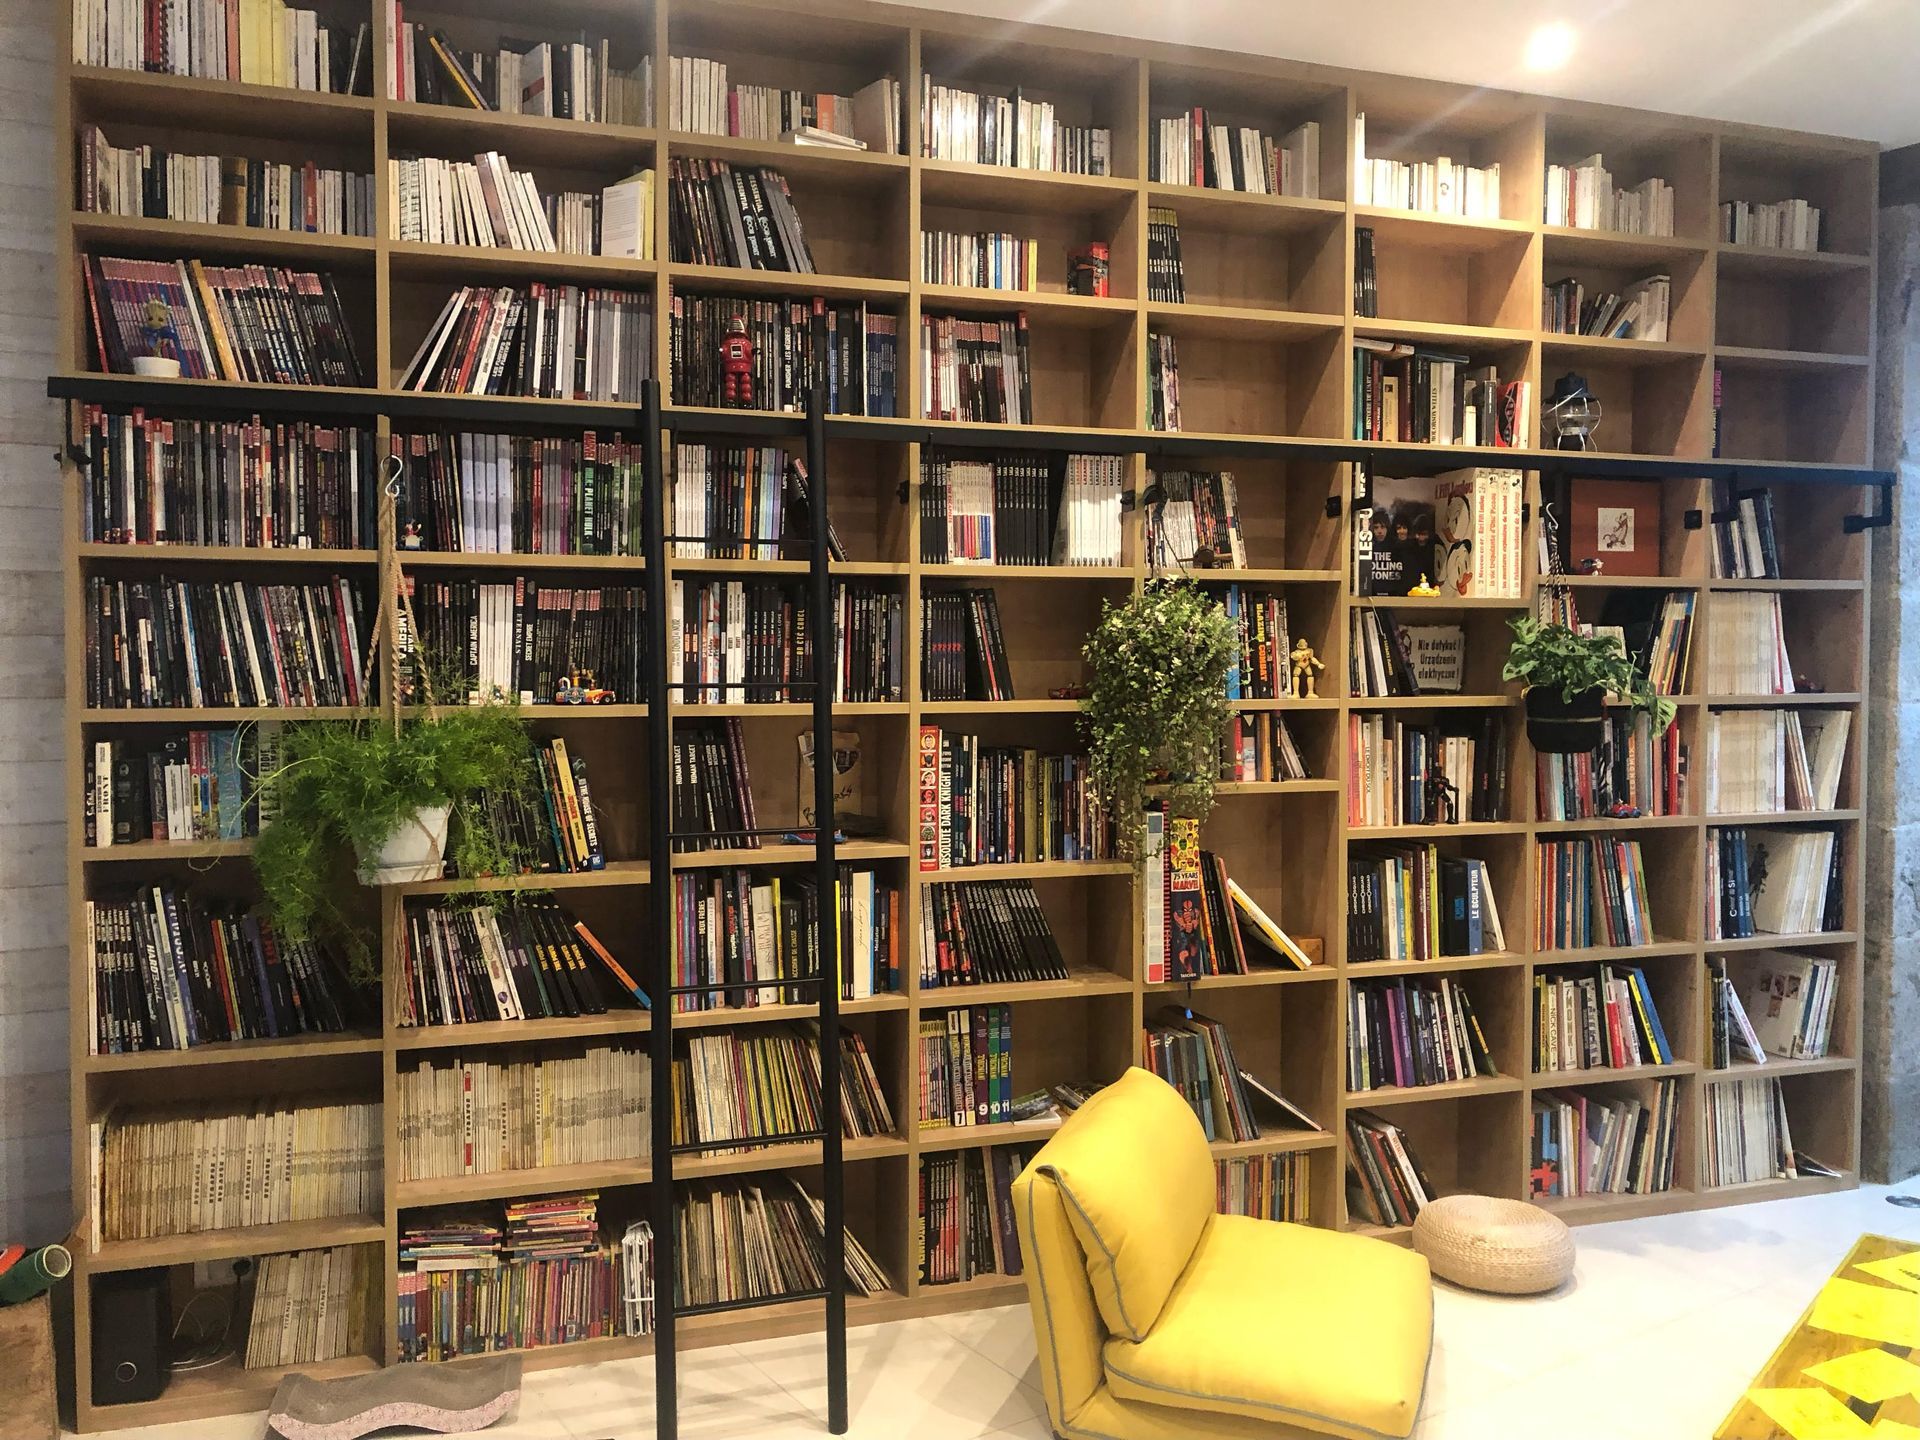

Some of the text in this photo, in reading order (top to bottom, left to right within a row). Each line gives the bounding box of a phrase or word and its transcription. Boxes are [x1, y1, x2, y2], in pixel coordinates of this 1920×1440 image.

[736, 178, 748, 210] ESSENTIAL
[750, 180, 763, 212] ESSENTIAL
[584, 488, 594, 514] PLANET
[1360, 530, 1373, 561] LES
[1374, 552, 1391, 561] THE
[1372, 562, 1403, 571] OLLING
[1372, 572, 1401, 580] TONES
[399, 609, 407, 659] AMERICA
[470, 616, 478, 666] CAPTAIN AMERICA
[1256, 604, 1267, 681] BLAZING COMBAT
[1418, 640, 1429, 650] Nie
[675, 765, 683, 785] HUMAN
[688, 744, 698, 784] HUMAN TARGET
[580, 786, 588, 796] THE
[582, 796, 590, 814] HOUSE
[941, 772, 951, 868] ABSOLUTE DARK KNIGHT
[587, 823, 597, 846] SECRETS
[1182, 872, 1198, 880] YEARS
[1471, 870, 1479, 919] LE SCULPTEUR
[147, 944, 160, 973] HARD
